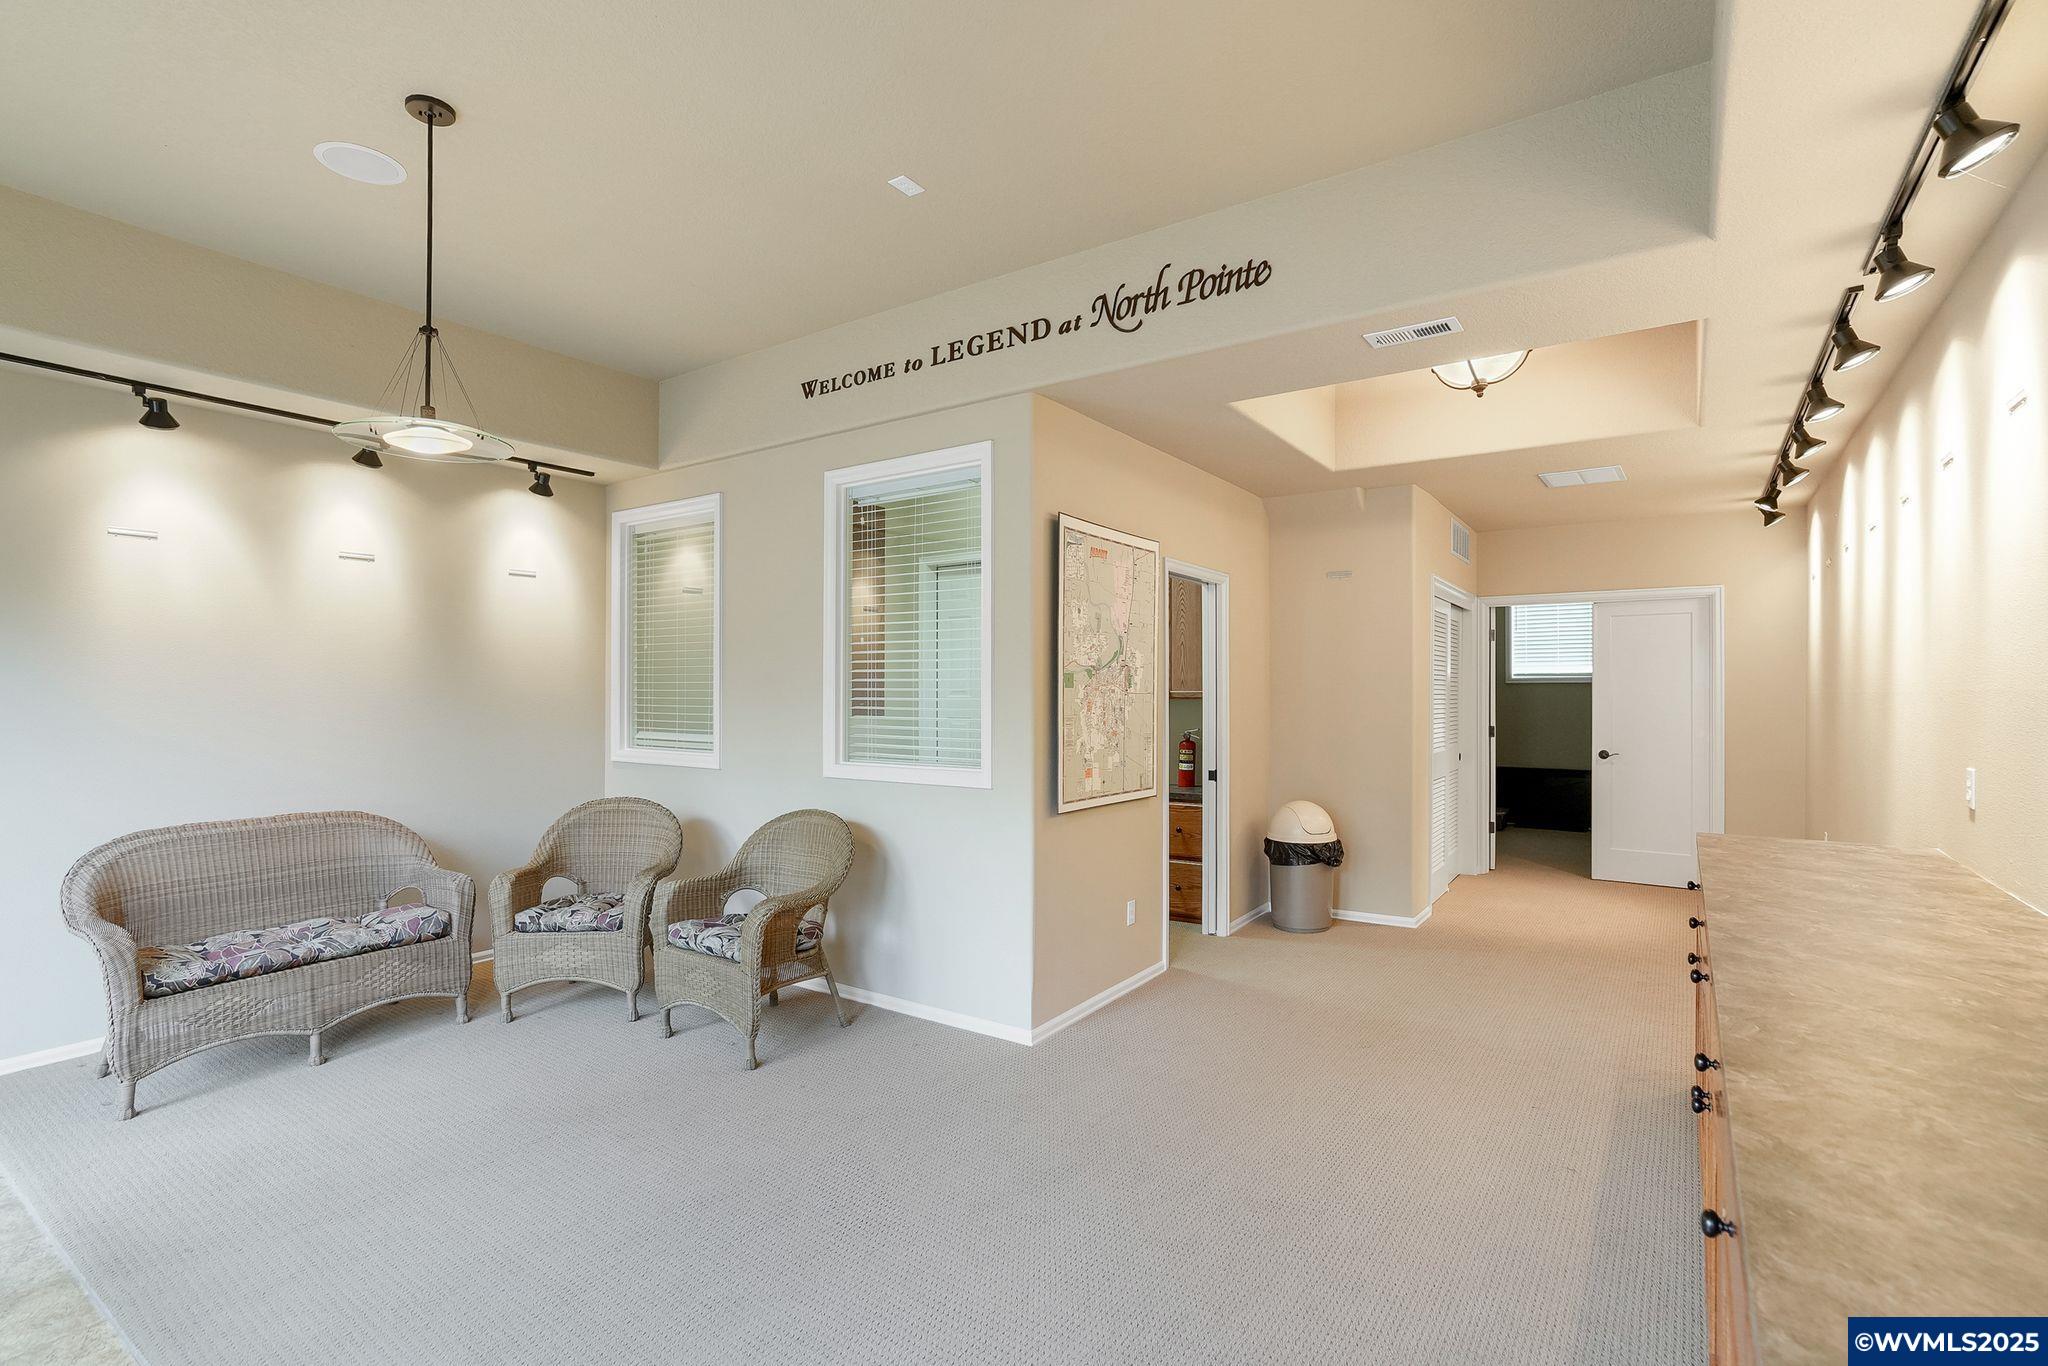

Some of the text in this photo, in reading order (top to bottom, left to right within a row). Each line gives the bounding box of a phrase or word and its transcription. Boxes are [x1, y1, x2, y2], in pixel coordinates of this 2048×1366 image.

[800, 258, 1273, 399] WELCOME to LEGEND at North Pointe
